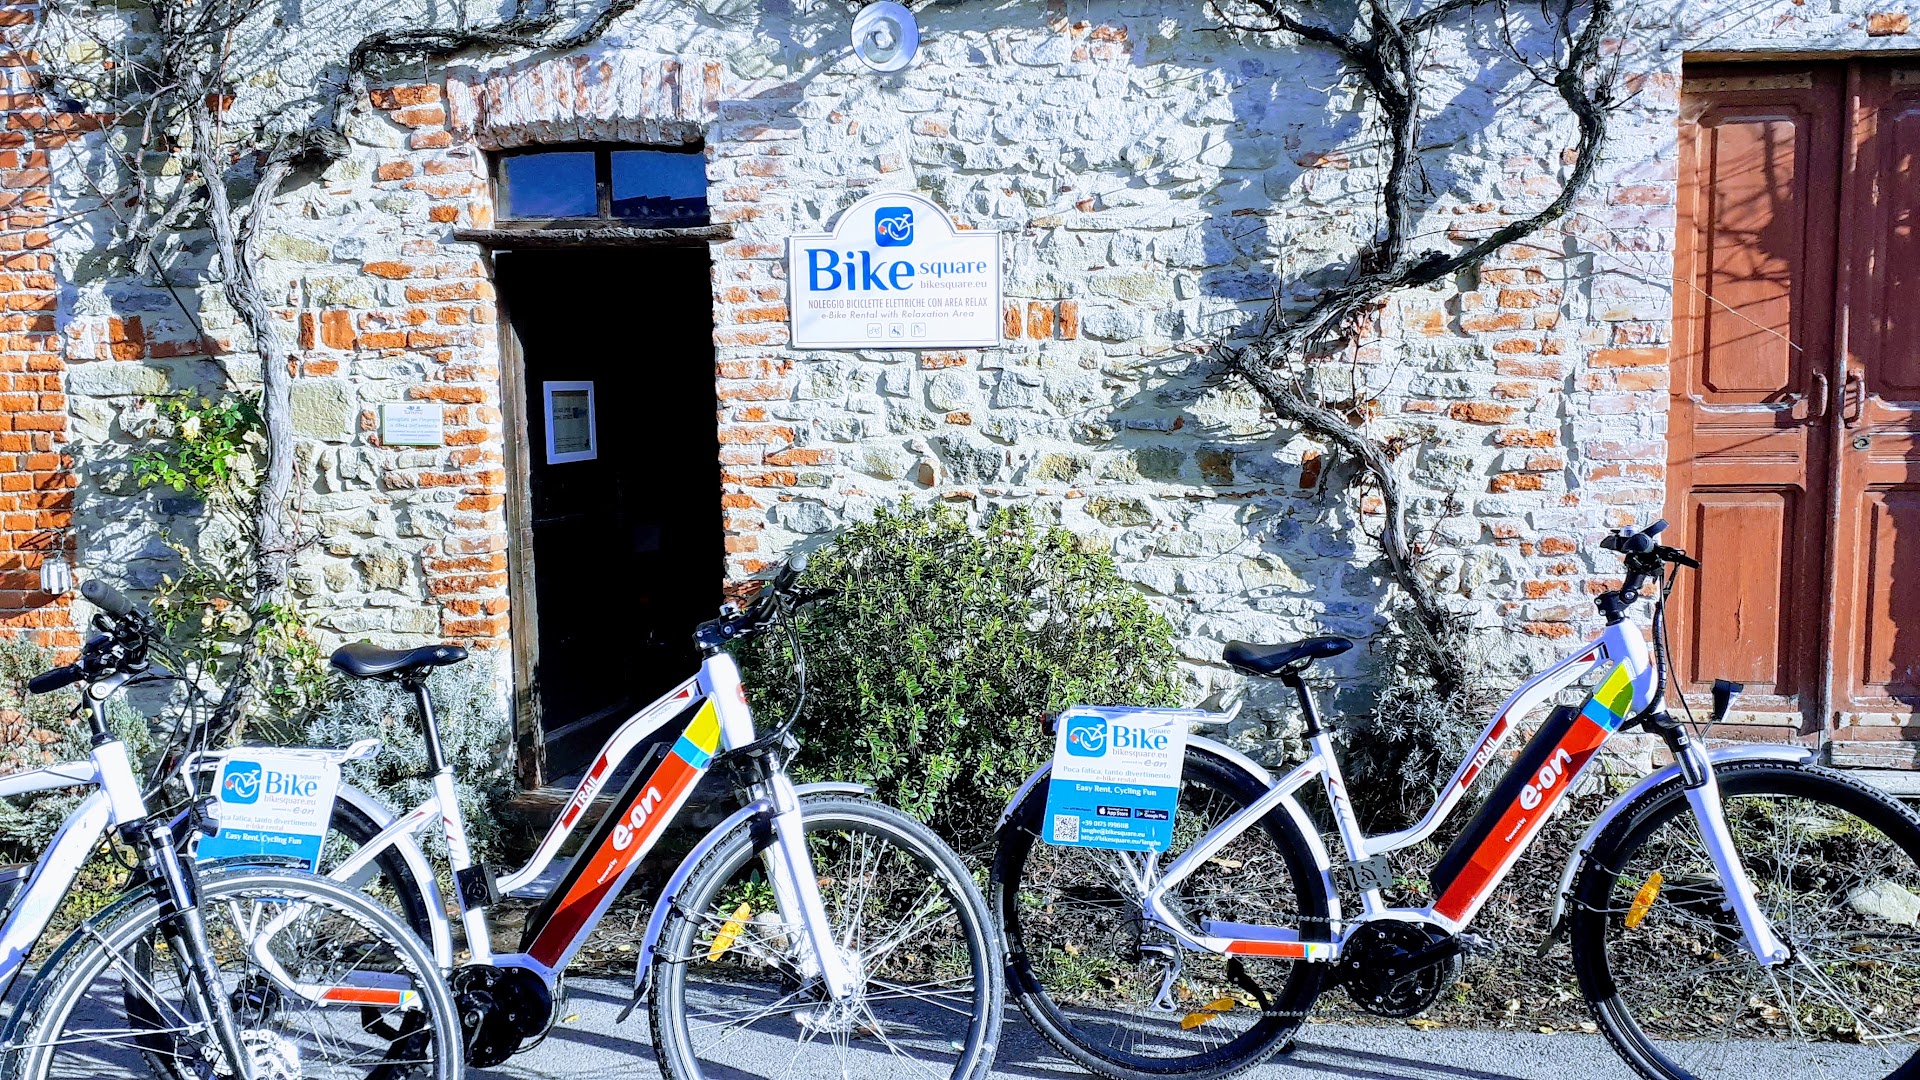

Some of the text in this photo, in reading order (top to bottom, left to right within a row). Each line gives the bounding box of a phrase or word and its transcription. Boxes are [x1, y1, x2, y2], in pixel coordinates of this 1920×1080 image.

[804, 249, 915, 291] Bike
[920, 280, 987, 290] bikesquare.eu
[808, 297, 988, 309] NOLEGGIO BICICLETTE ELETTRICHE CON AREA RELAX
[821, 311, 847, 319] e-Bike
[850, 310, 878, 319] Rental
[881, 309, 898, 318] with
[901, 310, 949, 318] Relaxation
[1111, 725, 1168, 750] Bike
[1112, 748, 1168, 758] bikesquare.eu
[1473, 737, 1499, 770] TRAIL
[1063, 765, 1080, 773] Poca
[1081, 766, 1102, 775] fatica,
[1125, 770, 1172, 779] divertimento
[265, 771, 318, 797] Bike
[1075, 783, 1157, 796] Easy Rent, Cycling Fun
[574, 774, 601, 810] TRAIL
[263, 794, 317, 805] bikesquare.eu
[232, 814, 252, 822] fatica,
[273, 817, 317, 827] divertimento
[225, 831, 241, 841] Easy
[260, 834, 287, 845] Cycling
[288, 837, 302, 845] Fun
[1505, 821, 1522, 842] Powered
